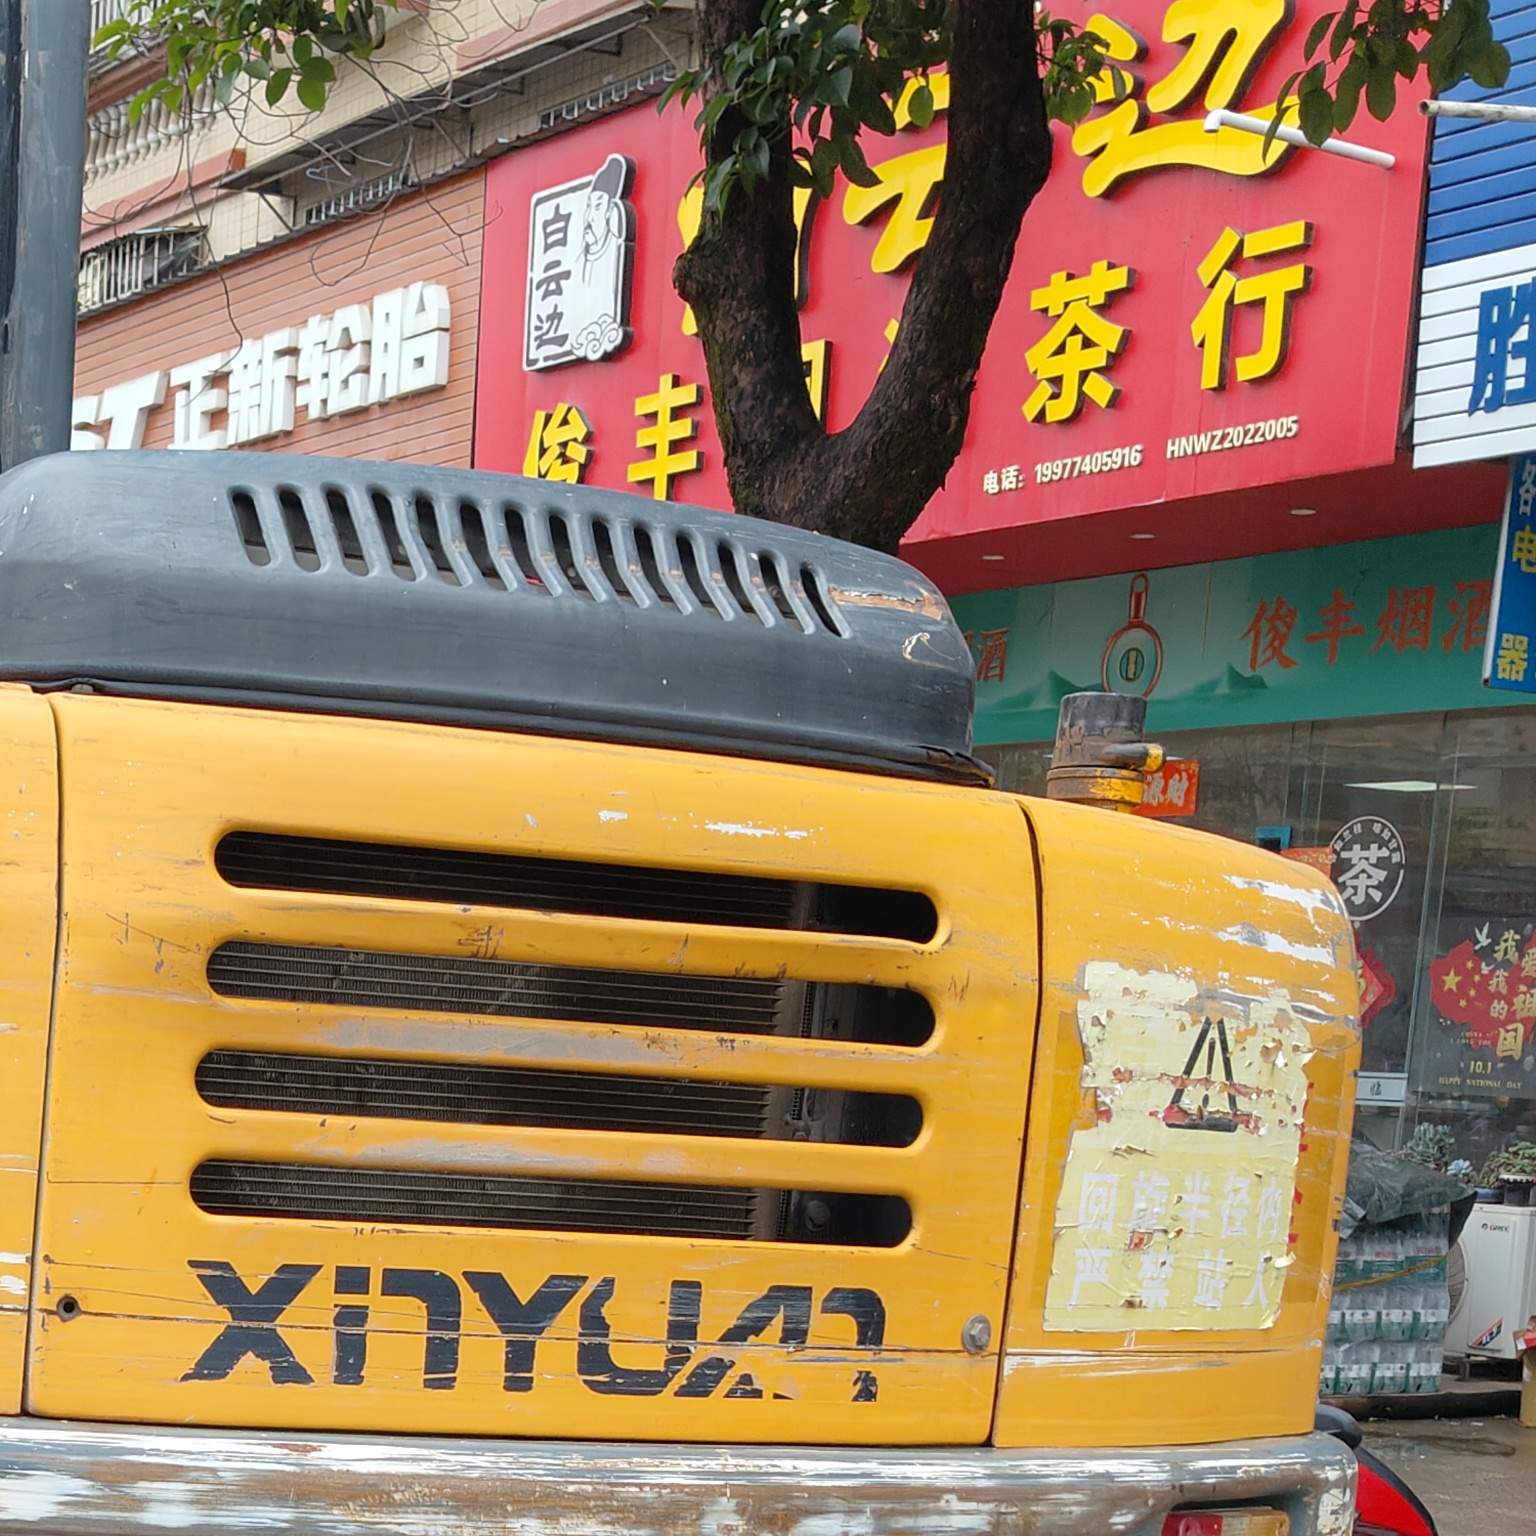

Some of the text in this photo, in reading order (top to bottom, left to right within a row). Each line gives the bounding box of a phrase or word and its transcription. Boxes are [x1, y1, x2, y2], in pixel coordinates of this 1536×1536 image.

[534, 203, 573, 350] 白云边
[169, 281, 450, 450] 正新轮胎
[1034, 444, 1144, 484] 19977405916
[1166, 415, 1300, 459] HNWZ2022005
[963, 627, 1009, 683] 酒
[1337, 843, 1390, 905] 茶
[1469, 1060, 1493, 1074] 10.1
[1078, 1168, 1283, 1239] 回旋半径内
[1066, 1247, 1271, 1312] 严禁站人
